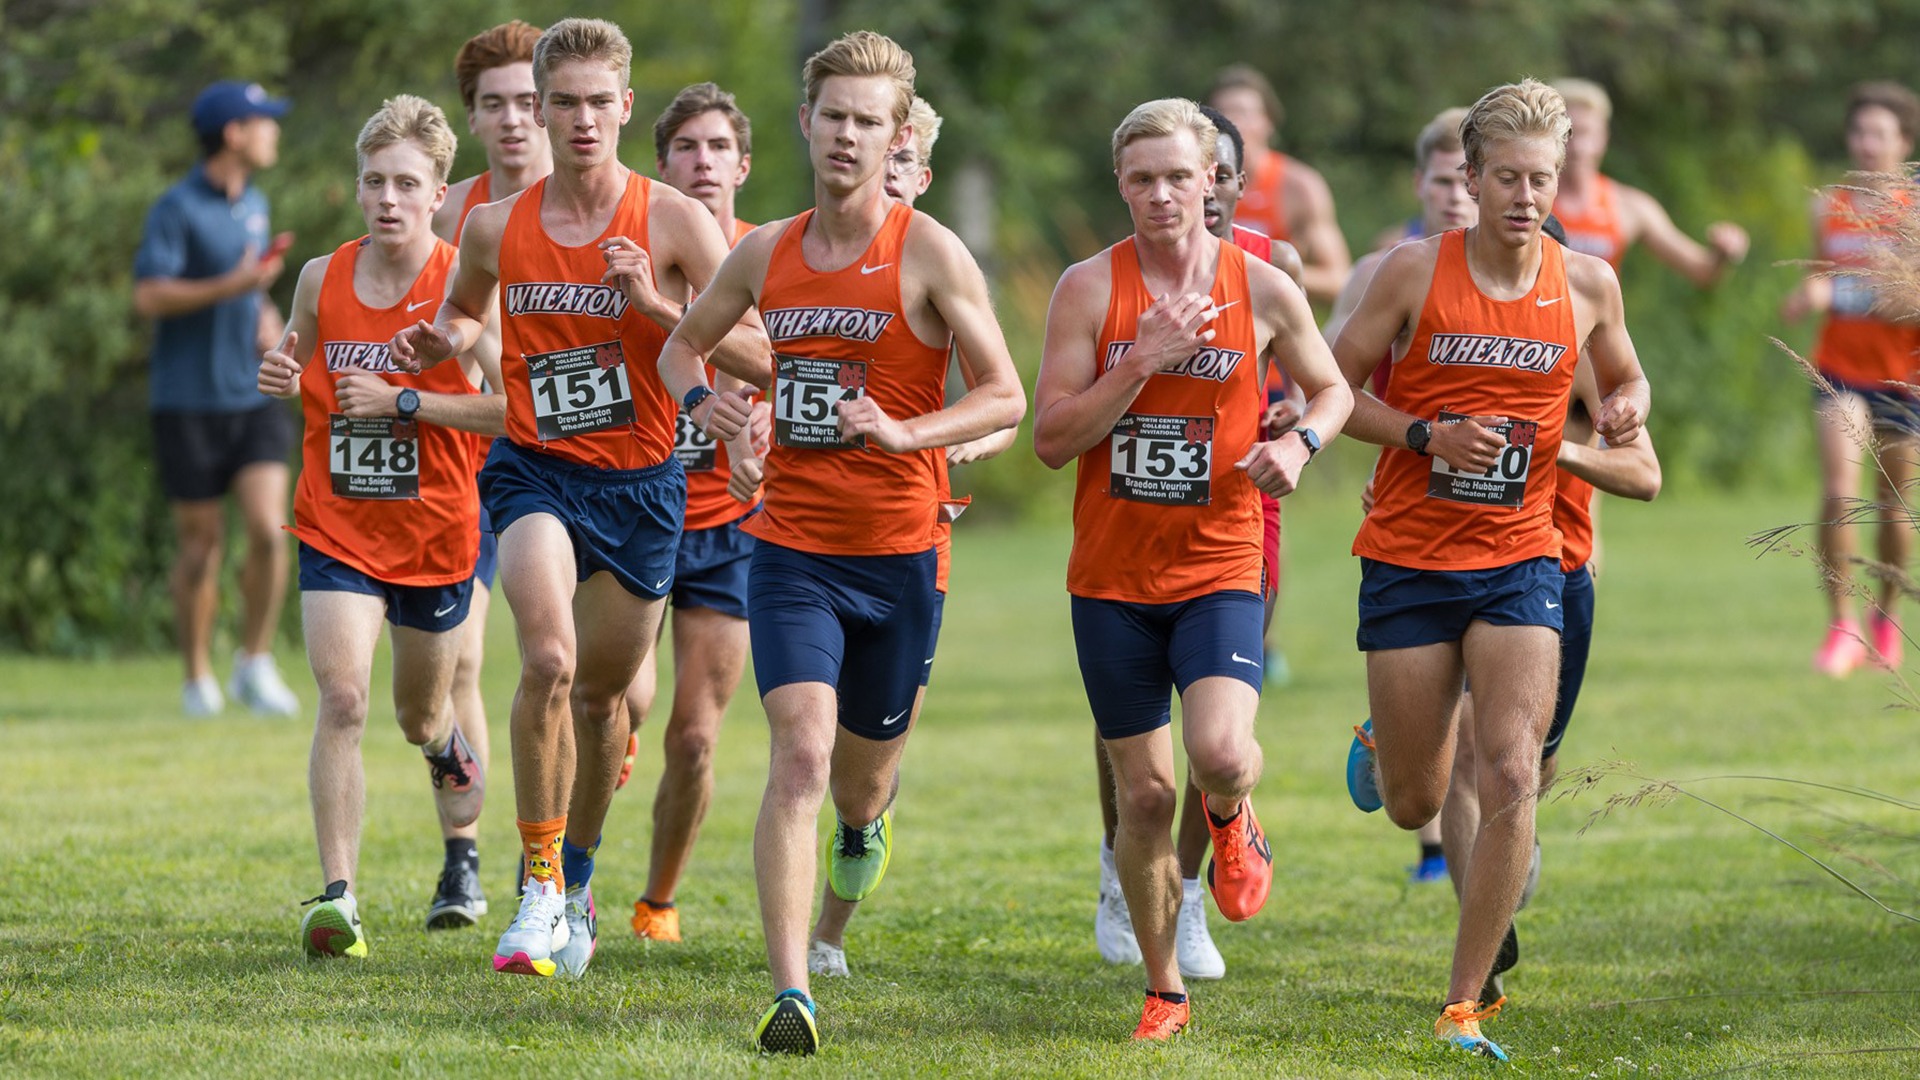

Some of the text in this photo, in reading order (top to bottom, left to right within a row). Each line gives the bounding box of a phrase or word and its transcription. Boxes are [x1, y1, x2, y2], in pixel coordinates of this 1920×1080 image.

[506, 282, 630, 320] WHEATON
[549, 348, 596, 360] NORTH CENTRAL
[1428, 333, 1568, 374] WHEATON
[555, 356, 582, 365] COLLEGE
[555, 361, 594, 371] INVITATIONAL
[794, 359, 840, 369] NORTH CENTRAL
[798, 366, 824, 374] COLLEGE
[797, 372, 835, 381] INVITATIONAL
[538, 366, 623, 413] 151
[557, 408, 612, 424] Drew Swiston
[561, 421, 595, 431] Wheaton
[792, 424, 835, 436] Luke Wertz
[789, 433, 821, 442] Wheaton
[335, 438, 416, 473] 148
[1118, 438, 1208, 478] 153
[349, 476, 394, 486] Luke Snider
[1125, 477, 1192, 491] Braedon Veurink
[1451, 478, 1506, 492] Jude Hubbard
[348, 485, 379, 493] Wheaton
[1132, 488, 1166, 498] Wheaton
[1452, 487, 1486, 498] Wheaton
